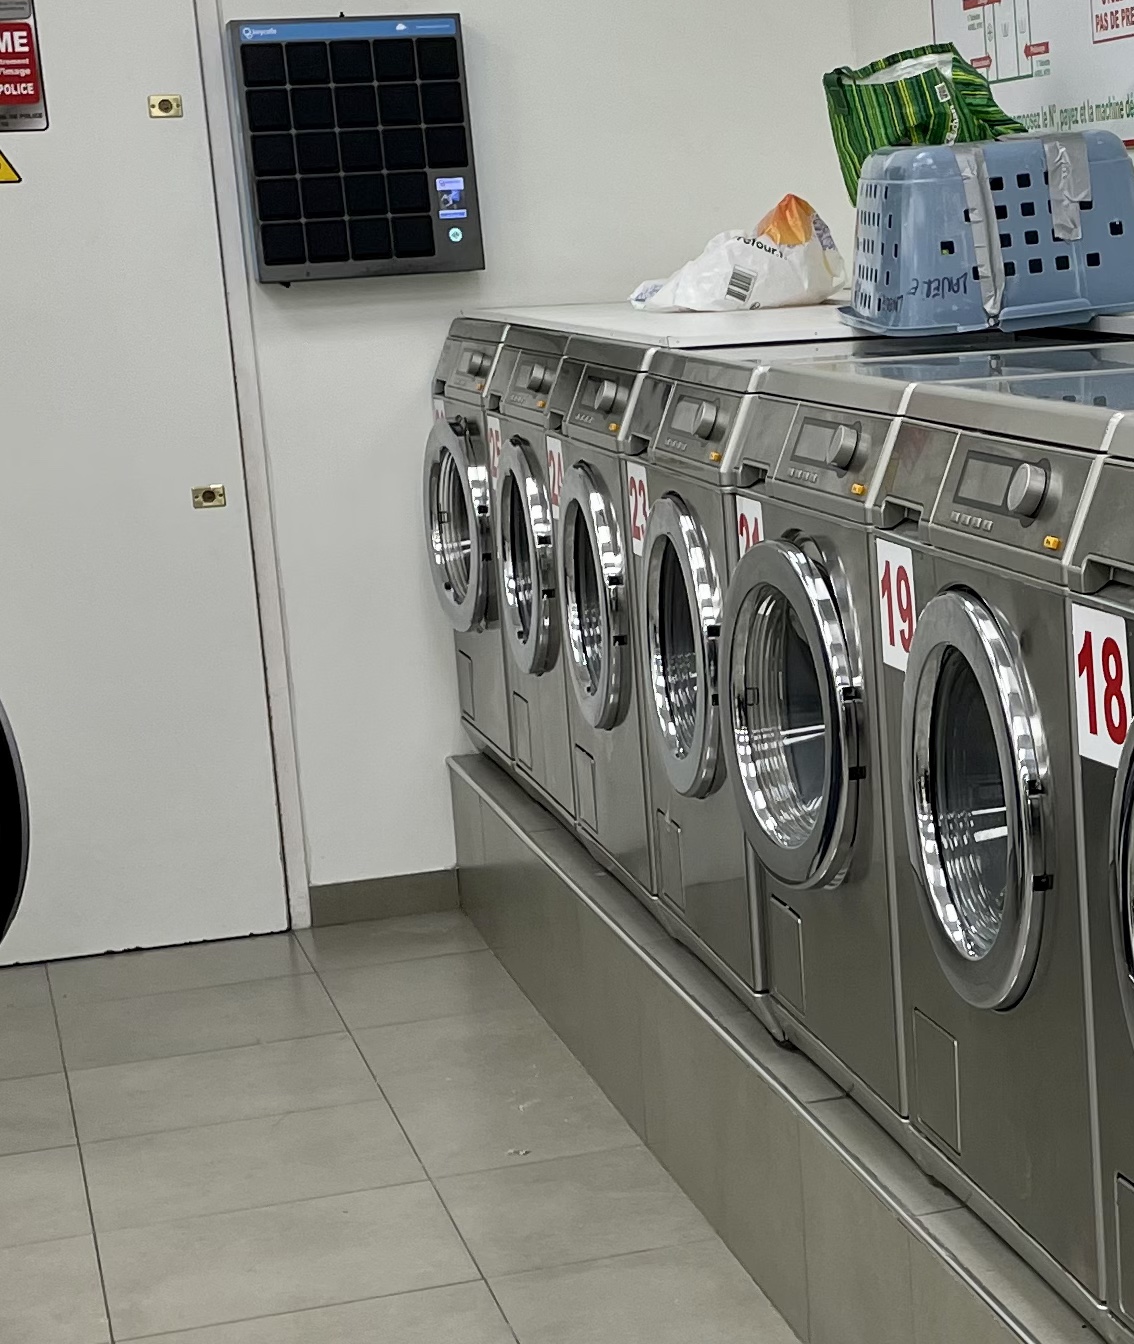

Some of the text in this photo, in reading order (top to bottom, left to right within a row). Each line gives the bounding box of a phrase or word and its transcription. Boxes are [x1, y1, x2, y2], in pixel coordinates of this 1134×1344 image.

[1095, 12, 1108, 32] PAS
[1110, 10, 1119, 30] DE
[908, 272, 967, 299] LAVERE
[881, 560, 913, 654] 19
[1077, 629, 1127, 745] 18
